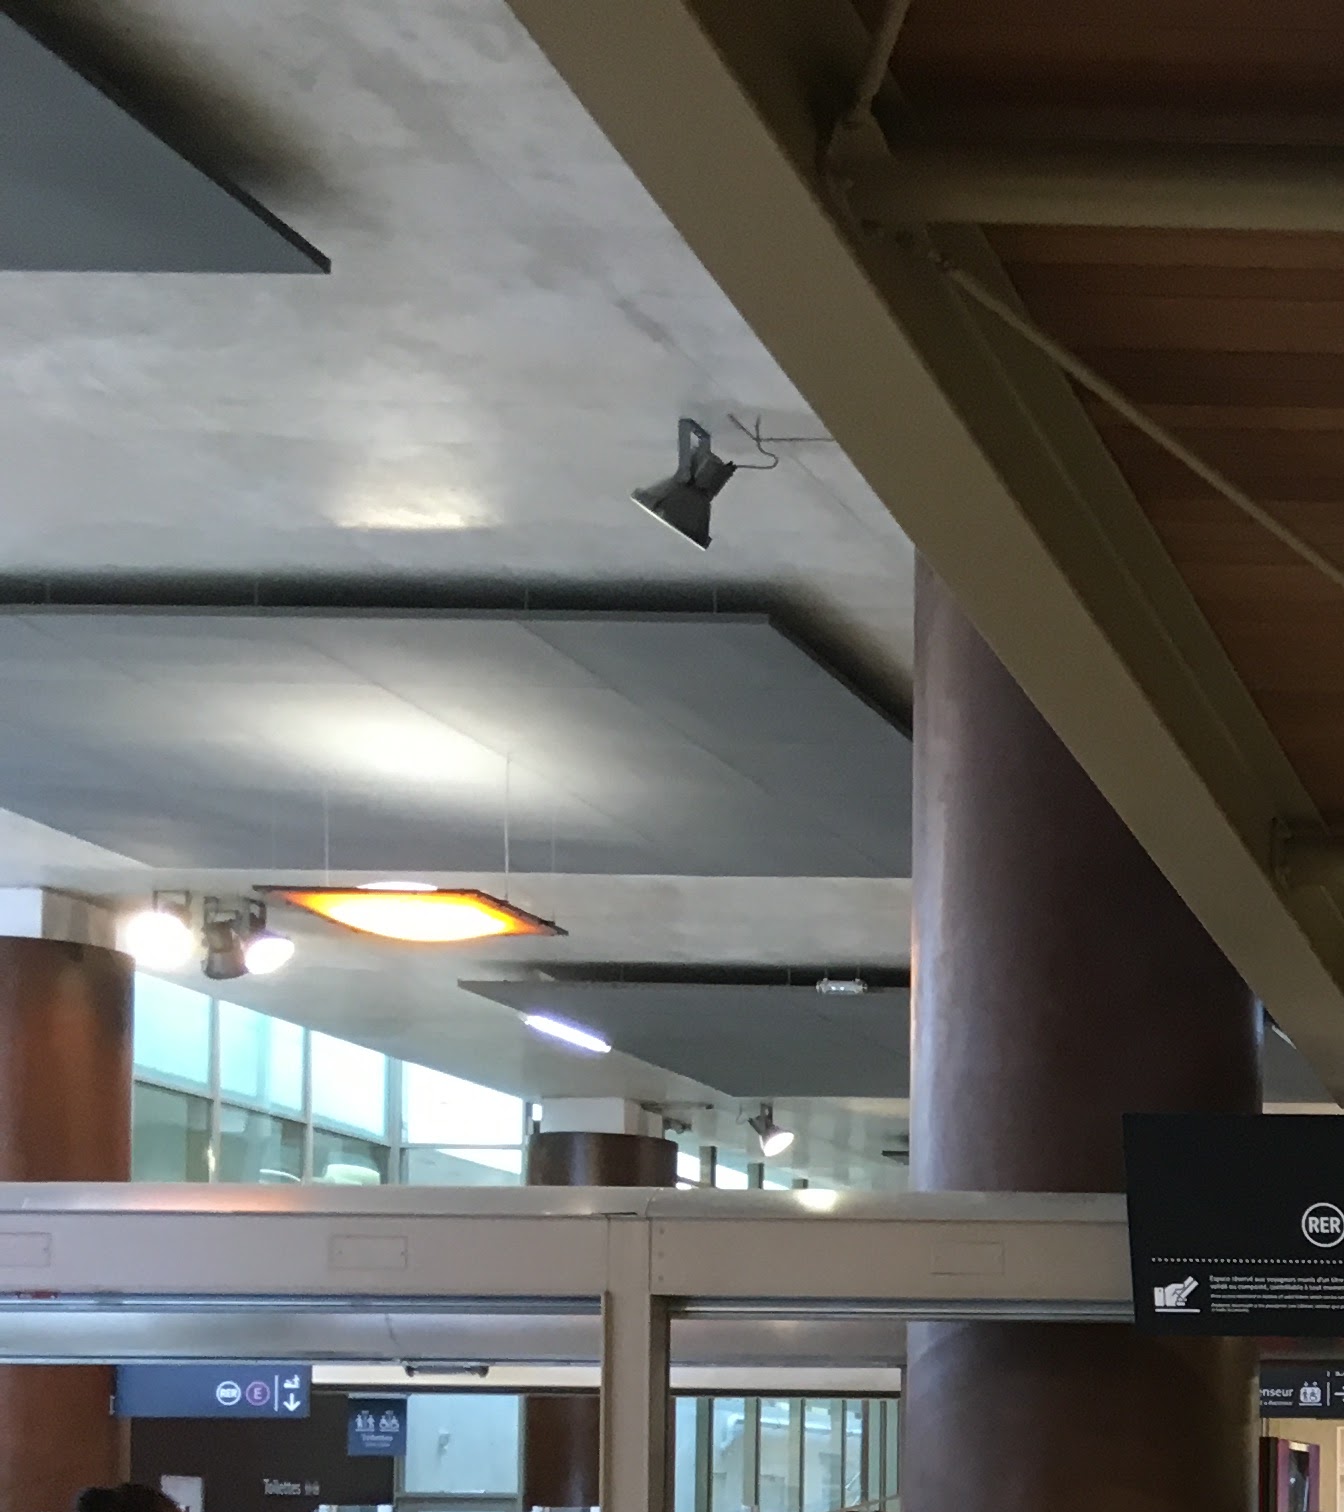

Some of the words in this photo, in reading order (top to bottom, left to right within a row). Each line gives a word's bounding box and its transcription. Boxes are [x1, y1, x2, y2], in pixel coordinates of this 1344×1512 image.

[1308, 1216, 1341, 1234] RER
[219, 1388, 238, 1398] RER
[253, 1388, 262, 1399] E
